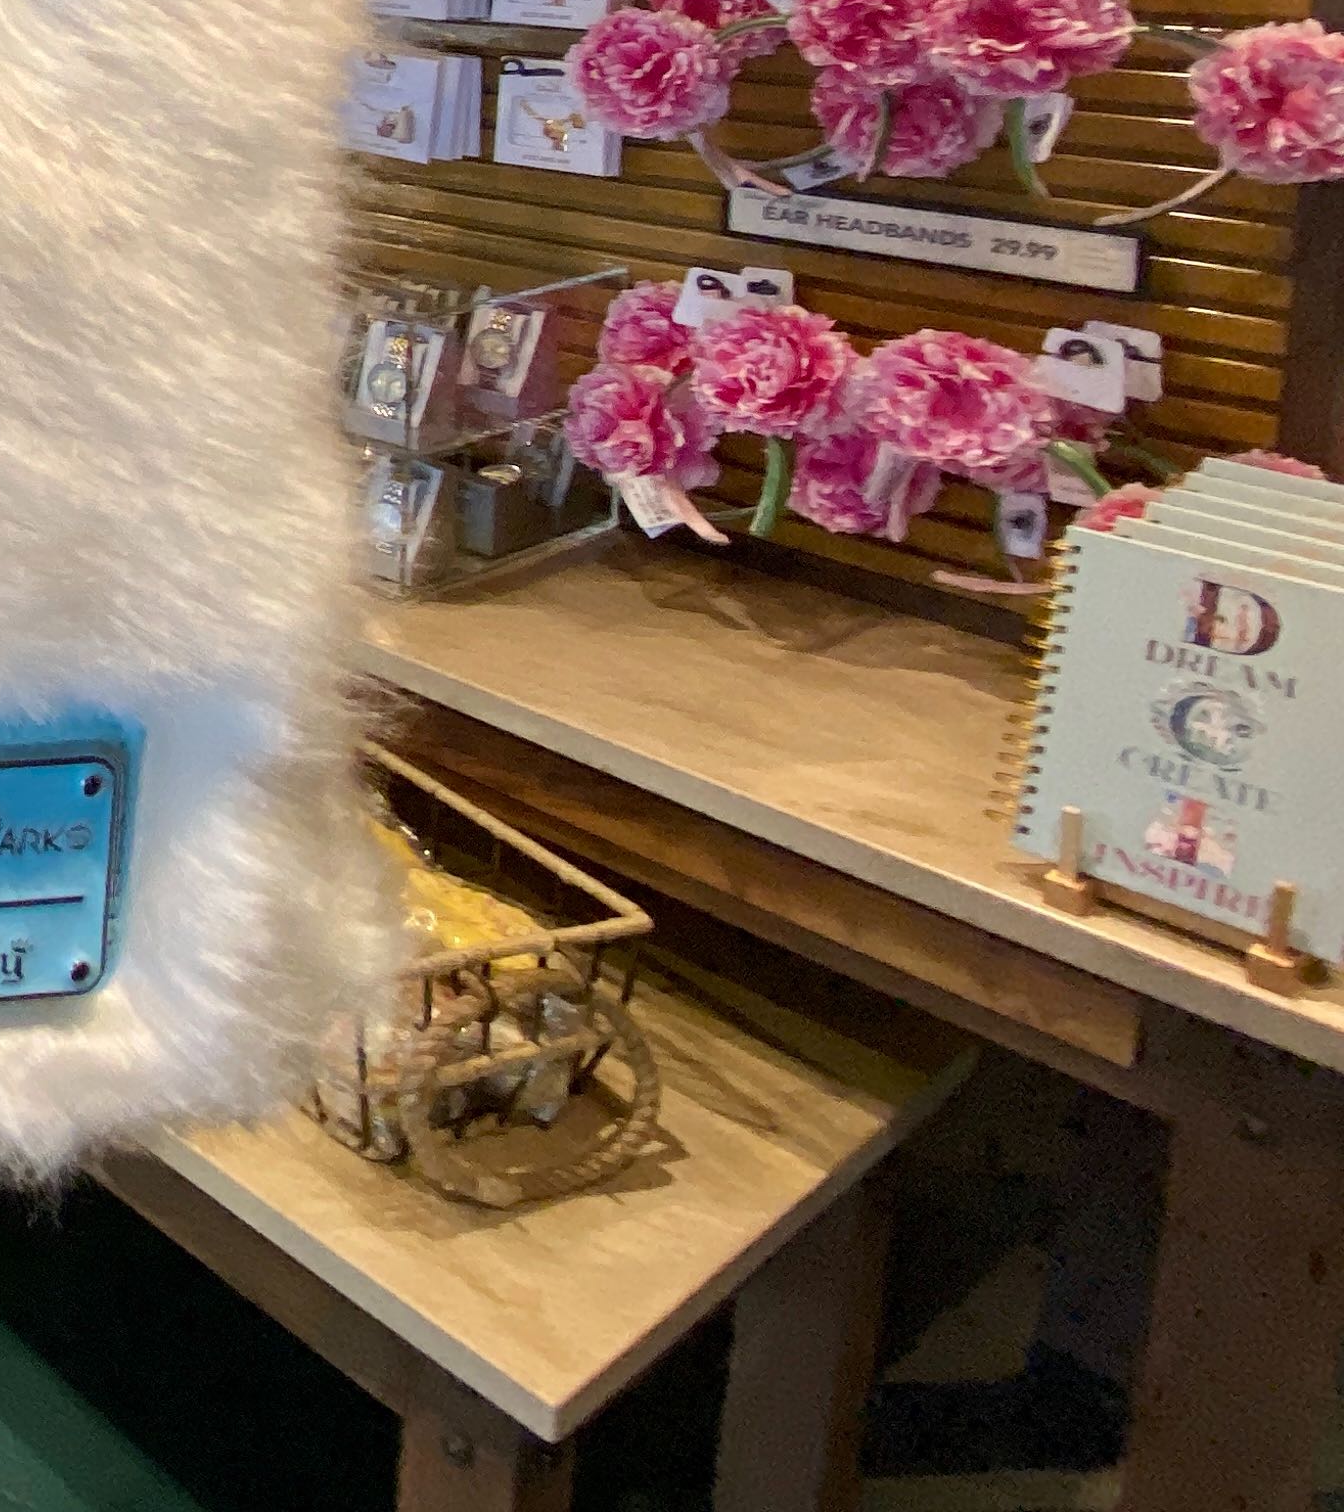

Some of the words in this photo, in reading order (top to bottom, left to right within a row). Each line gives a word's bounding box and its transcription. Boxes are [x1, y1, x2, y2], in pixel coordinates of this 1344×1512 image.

[815, 214, 973, 249] HEADBANDS
[990, 237, 1060, 261] 29.99
[1145, 639, 1298, 699] DREAM
[1117, 745, 1281, 815] CREATE
